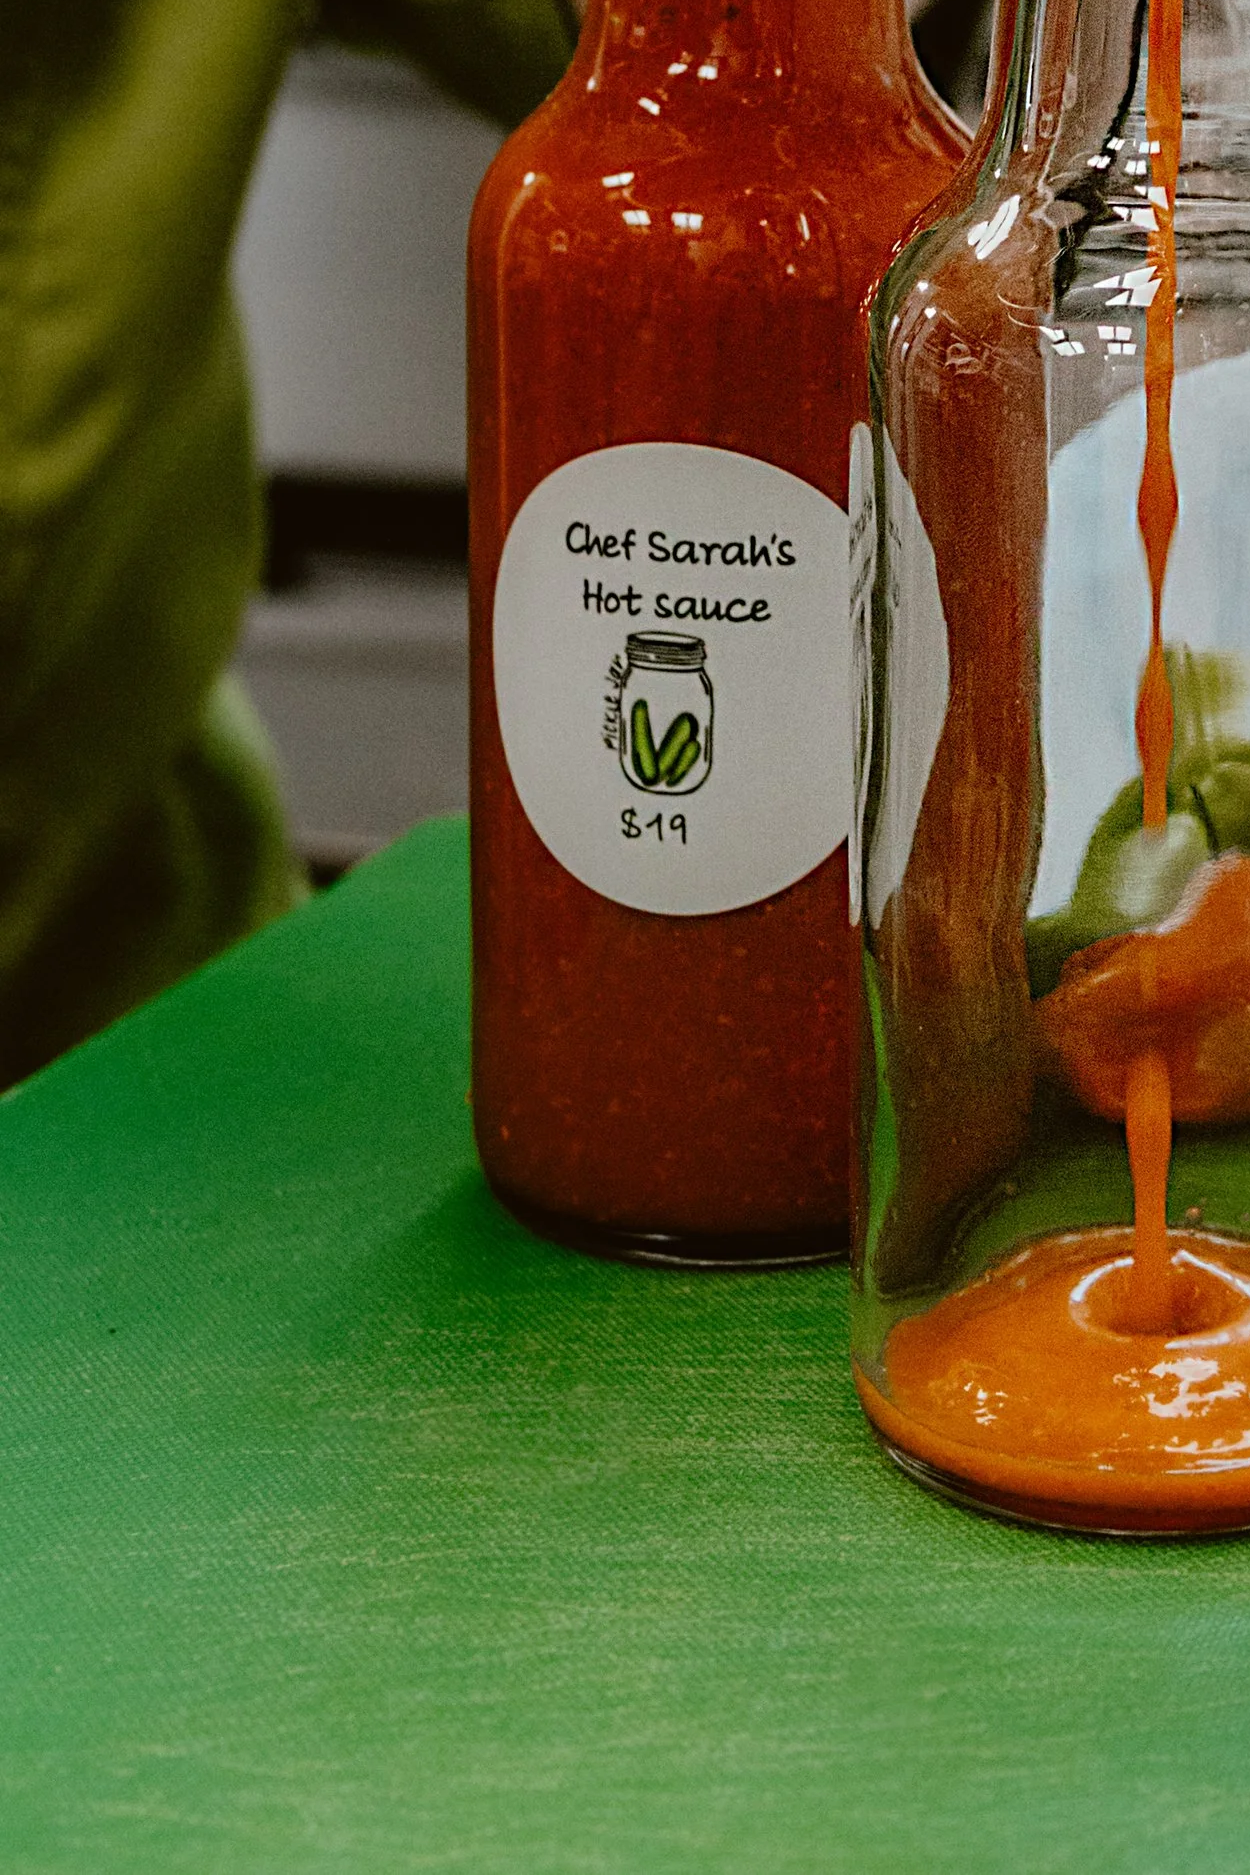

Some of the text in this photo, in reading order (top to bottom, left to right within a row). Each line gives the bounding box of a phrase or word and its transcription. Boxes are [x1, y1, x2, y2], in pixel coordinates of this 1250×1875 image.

[566, 521, 797, 568] Chef Sarah's
[583, 579, 773, 624] Hot sauce
[621, 807, 687, 846] $19
